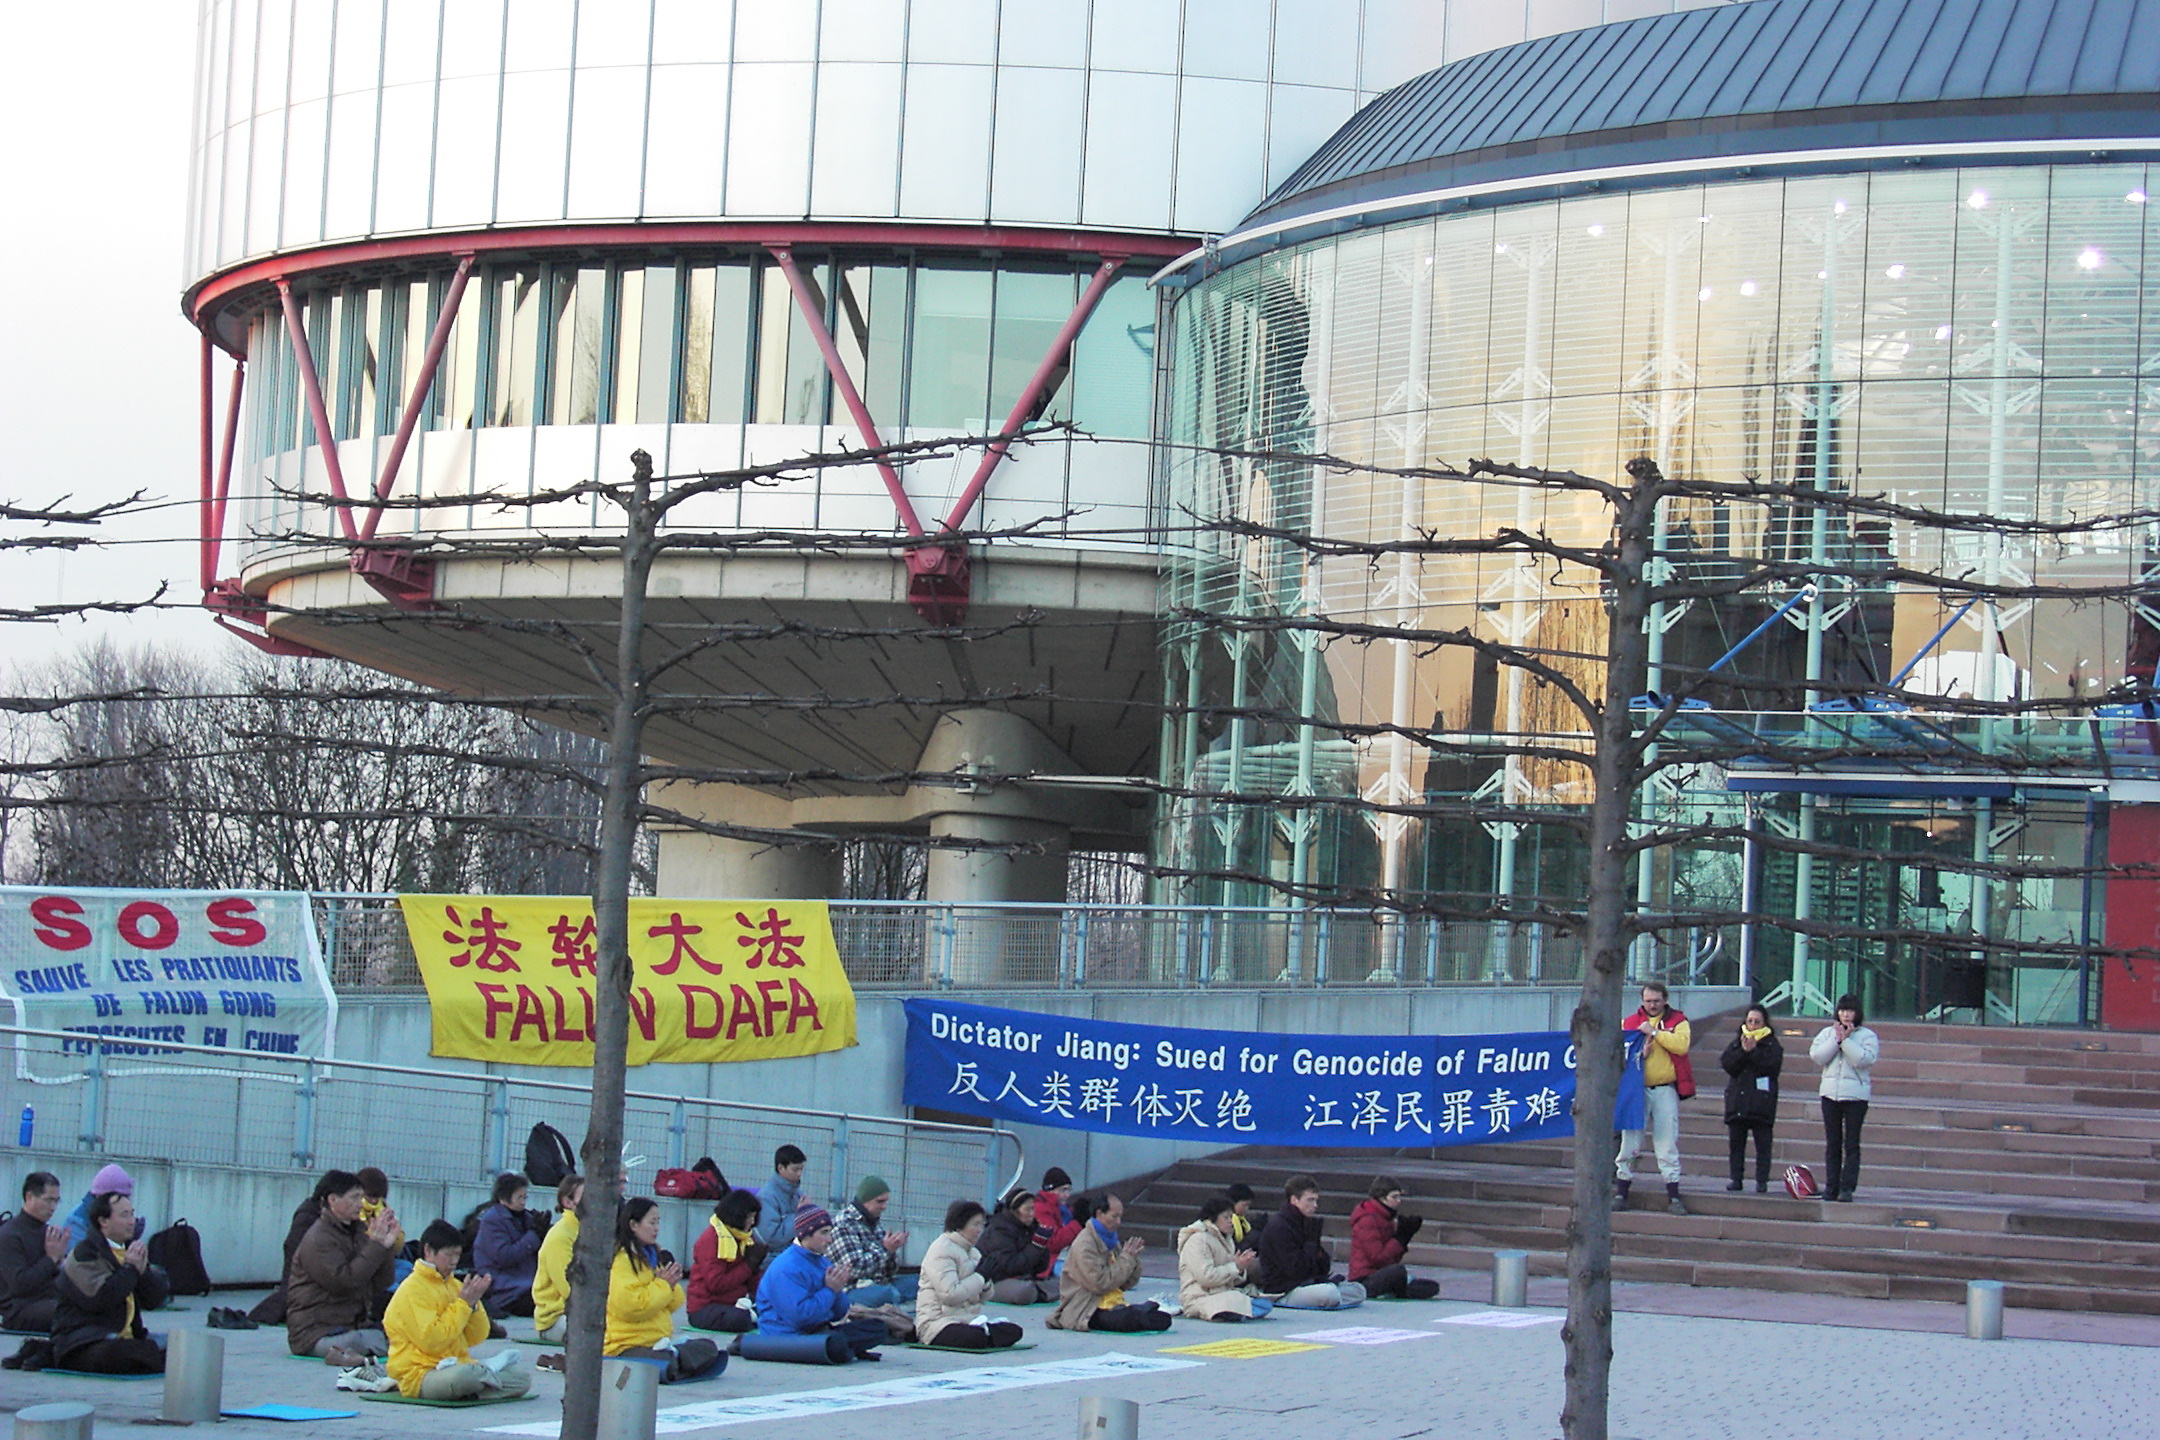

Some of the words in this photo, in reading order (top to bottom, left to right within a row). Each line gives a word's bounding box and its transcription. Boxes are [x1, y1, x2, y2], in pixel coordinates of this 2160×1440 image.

[15, 963, 91, 993] SAUVE
[112, 958, 153, 983] LES
[160, 956, 302, 983] PRATIQUANTS
[91, 993, 123, 1017] DE
[140, 990, 208, 1015] FALUN
[219, 990, 276, 1018] GONG
[678, 978, 823, 1040] DAFA
[203, 1026, 228, 1056] EN
[931, 1012, 1042, 1053] Dictator
[1056, 1031, 1141, 1070] Jiang:
[1156, 1041, 1226, 1071] Sued
[1239, 1047, 1279, 1074] for
[1293, 1048, 1422, 1076] Genocide
[1436, 1048, 1465, 1075] of
[1477, 1046, 1551, 1074] Falun
[948, 1062, 1257, 1131] 反人类群体灭绝
[1303, 1087, 1575, 1135] 江泽民罪责难
